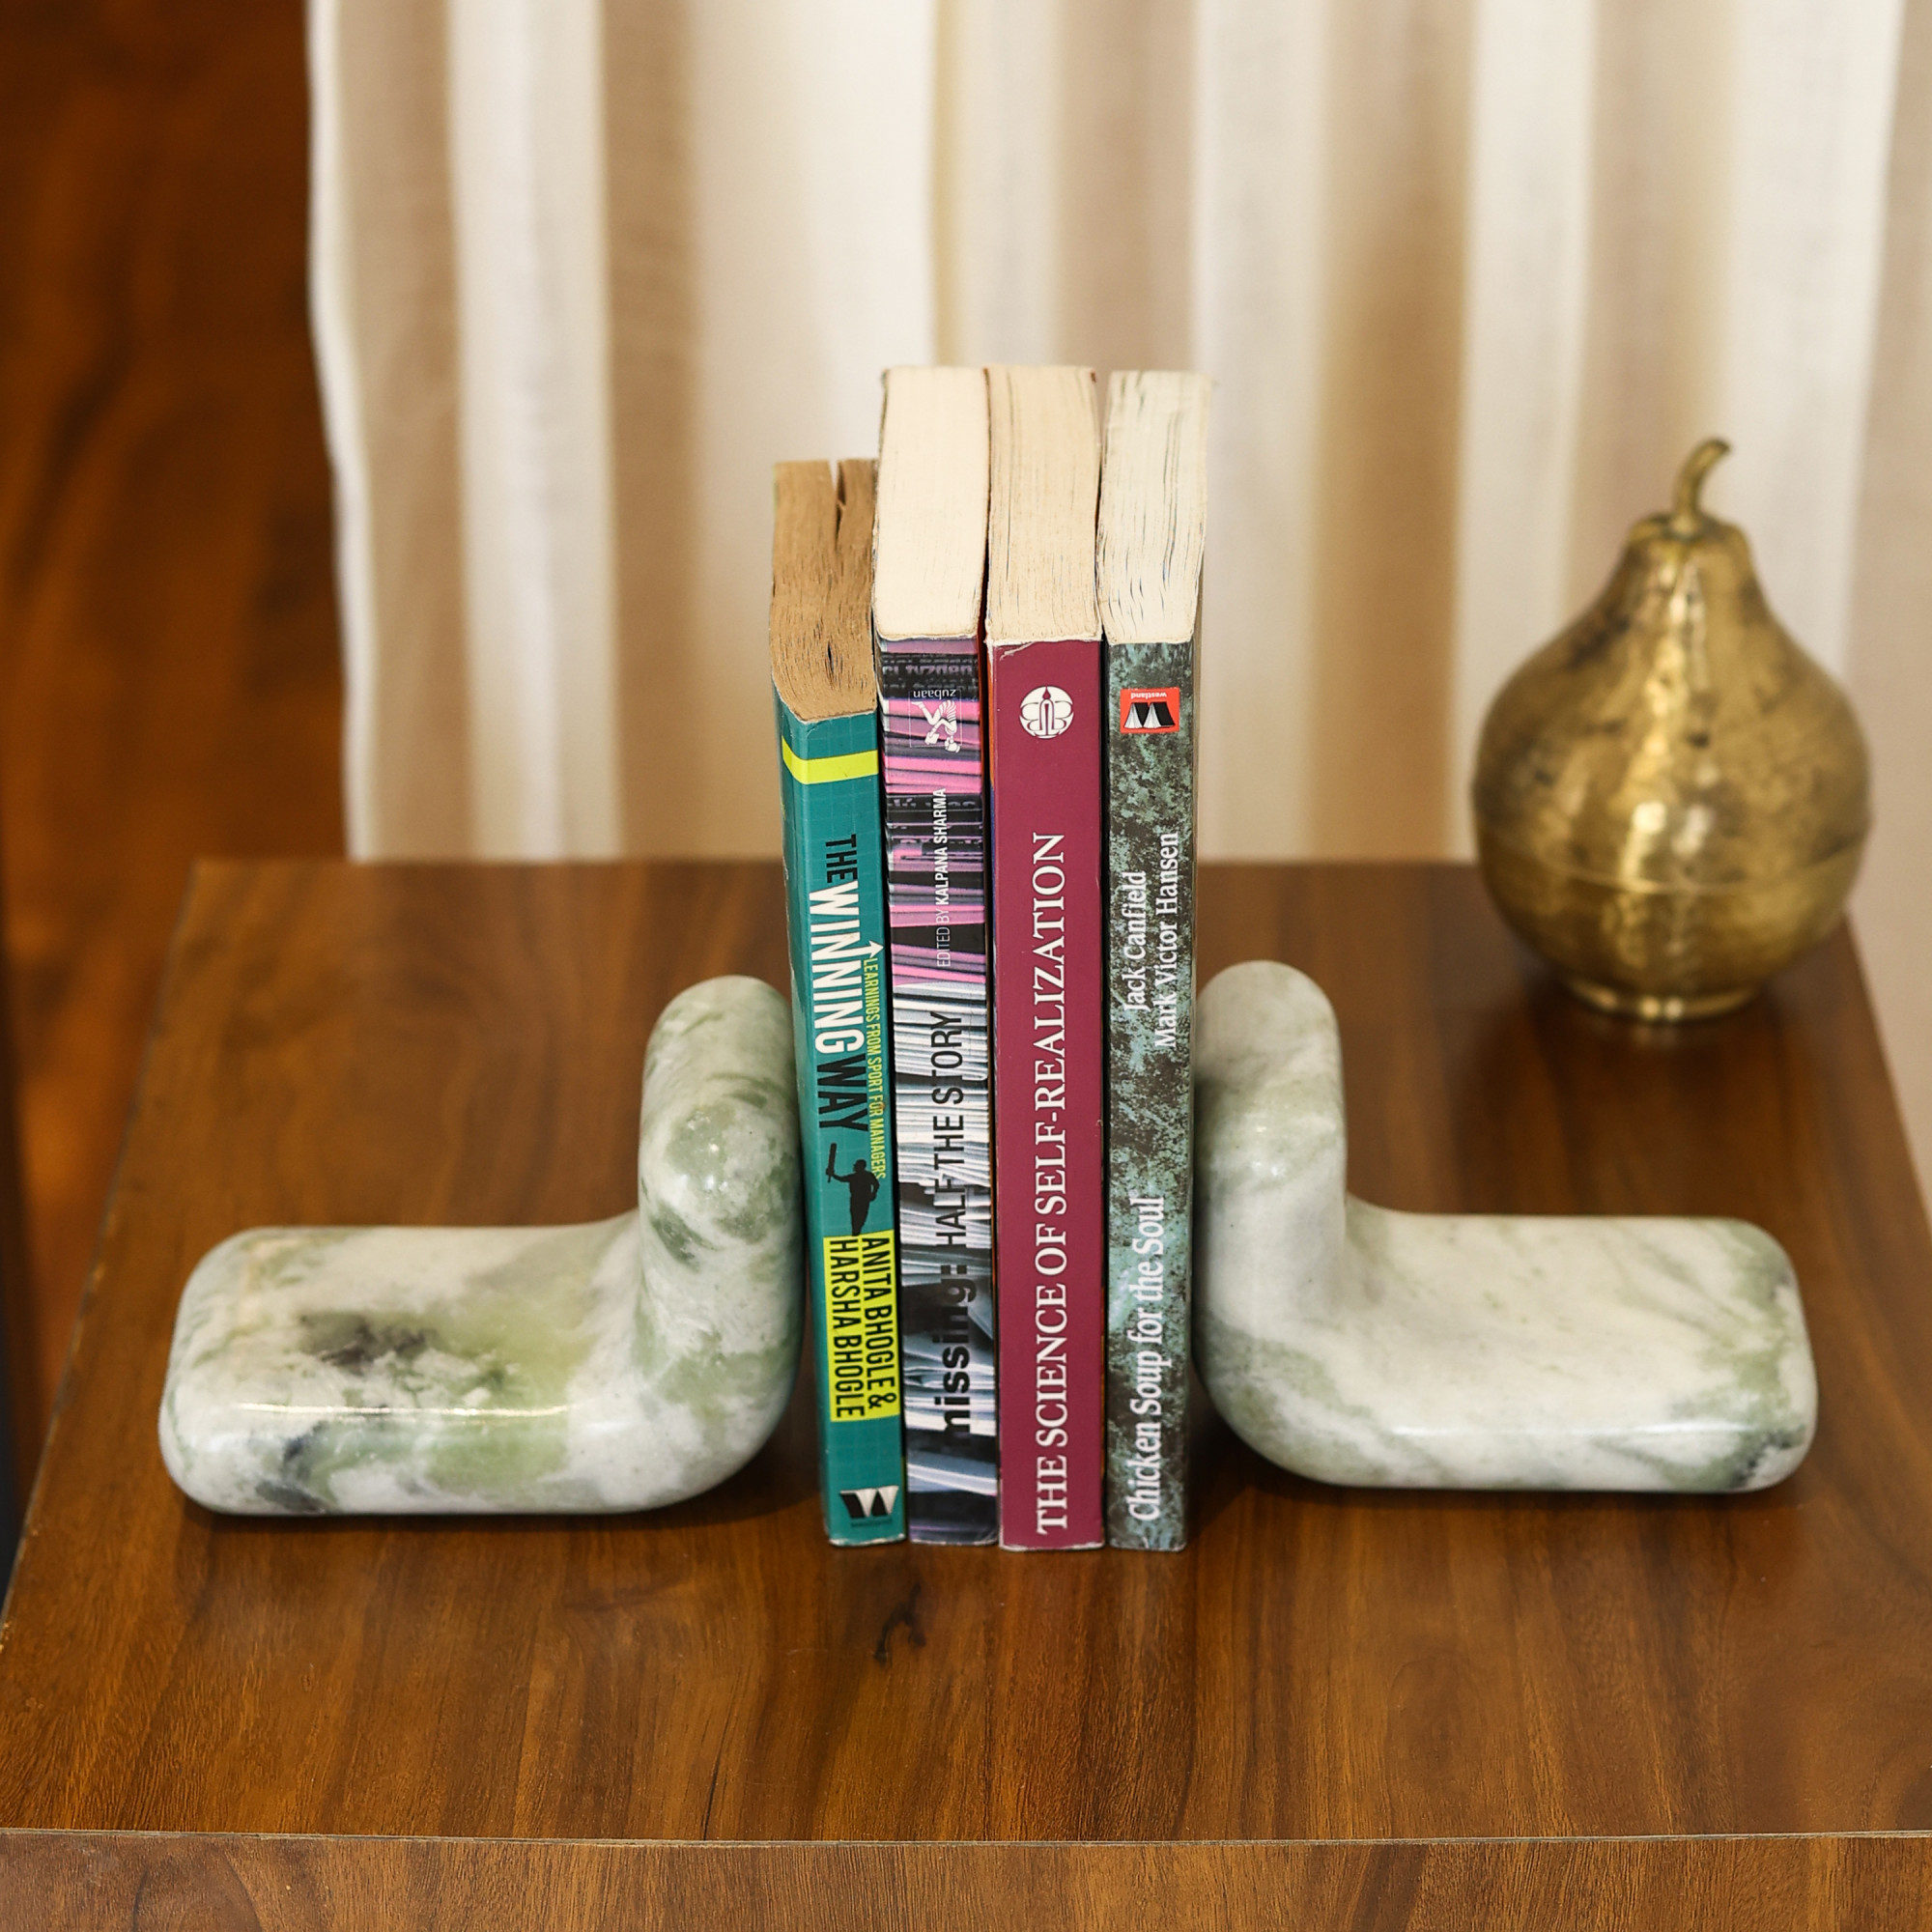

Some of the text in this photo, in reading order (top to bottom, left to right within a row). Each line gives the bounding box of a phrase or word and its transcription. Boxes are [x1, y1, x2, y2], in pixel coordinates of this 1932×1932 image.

[913, 689, 956, 700] zubaan
[932, 787, 952, 968] EDITED BY KALPANA SHARMA
[1122, 870, 1151, 1011] Jack Canfield
[1152, 832, 1179, 1049] Mark Victor Hansen
[809, 834, 868, 1131] THE WINNING WAY
[864, 958, 887, 1179] LEARNINGS FROM SPORT FOR MANAGERS
[929, 1011, 964, 1104] STORY
[932, 1115, 964, 1171] THE
[933, 1179, 966, 1248] HALF
[1033, 832, 1067, 1535] THE SCIENCE OF SELF-REALIZATION
[830, 1238, 865, 1418] HARSHA BHOGLE
[862, 1237, 897, 1409] ANITA BHOGLE &
[1125, 1197, 1172, 1521] Chicken Soup for the Soul
